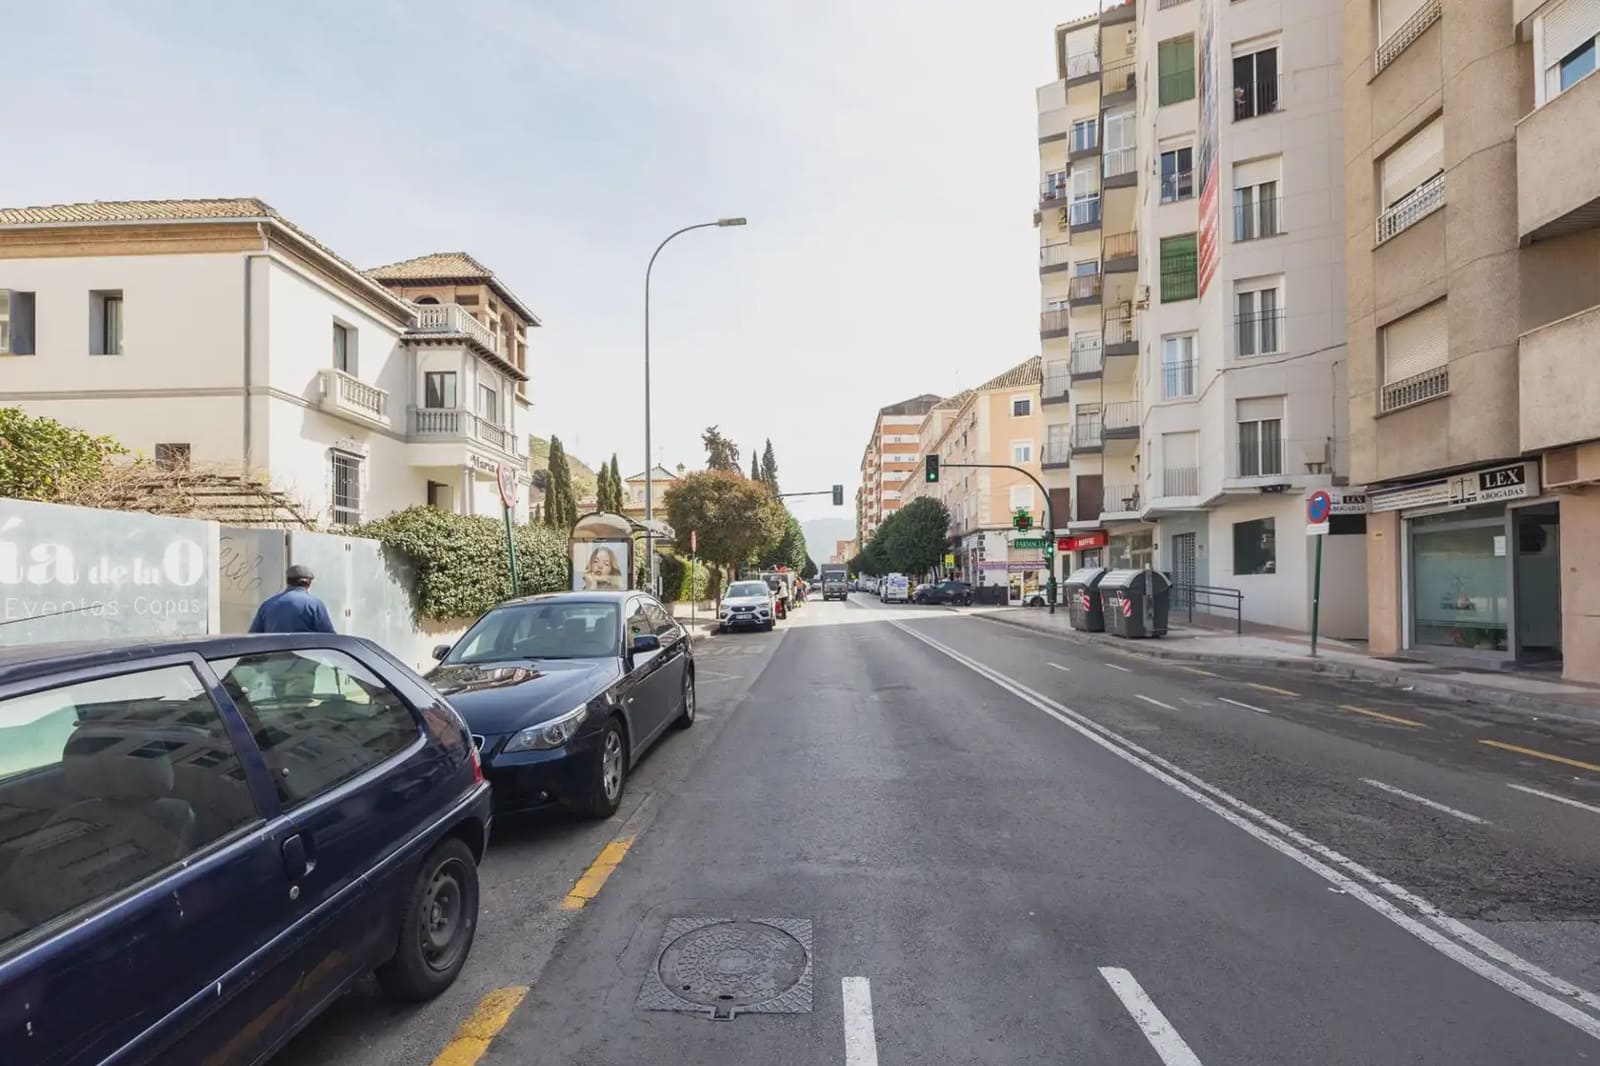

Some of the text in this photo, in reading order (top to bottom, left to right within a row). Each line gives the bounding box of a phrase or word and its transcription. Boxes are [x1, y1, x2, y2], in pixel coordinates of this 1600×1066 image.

[1484, 468, 1520, 488] LEX
[1345, 494, 1363, 504] LEX
[1480, 487, 1525, 502] ABOGADAS
[88, 555, 129, 584] de
[133, 557, 160, 584] la
[163, 538, 204, 586] O
[5, 596, 201, 619] Eventos Copas
